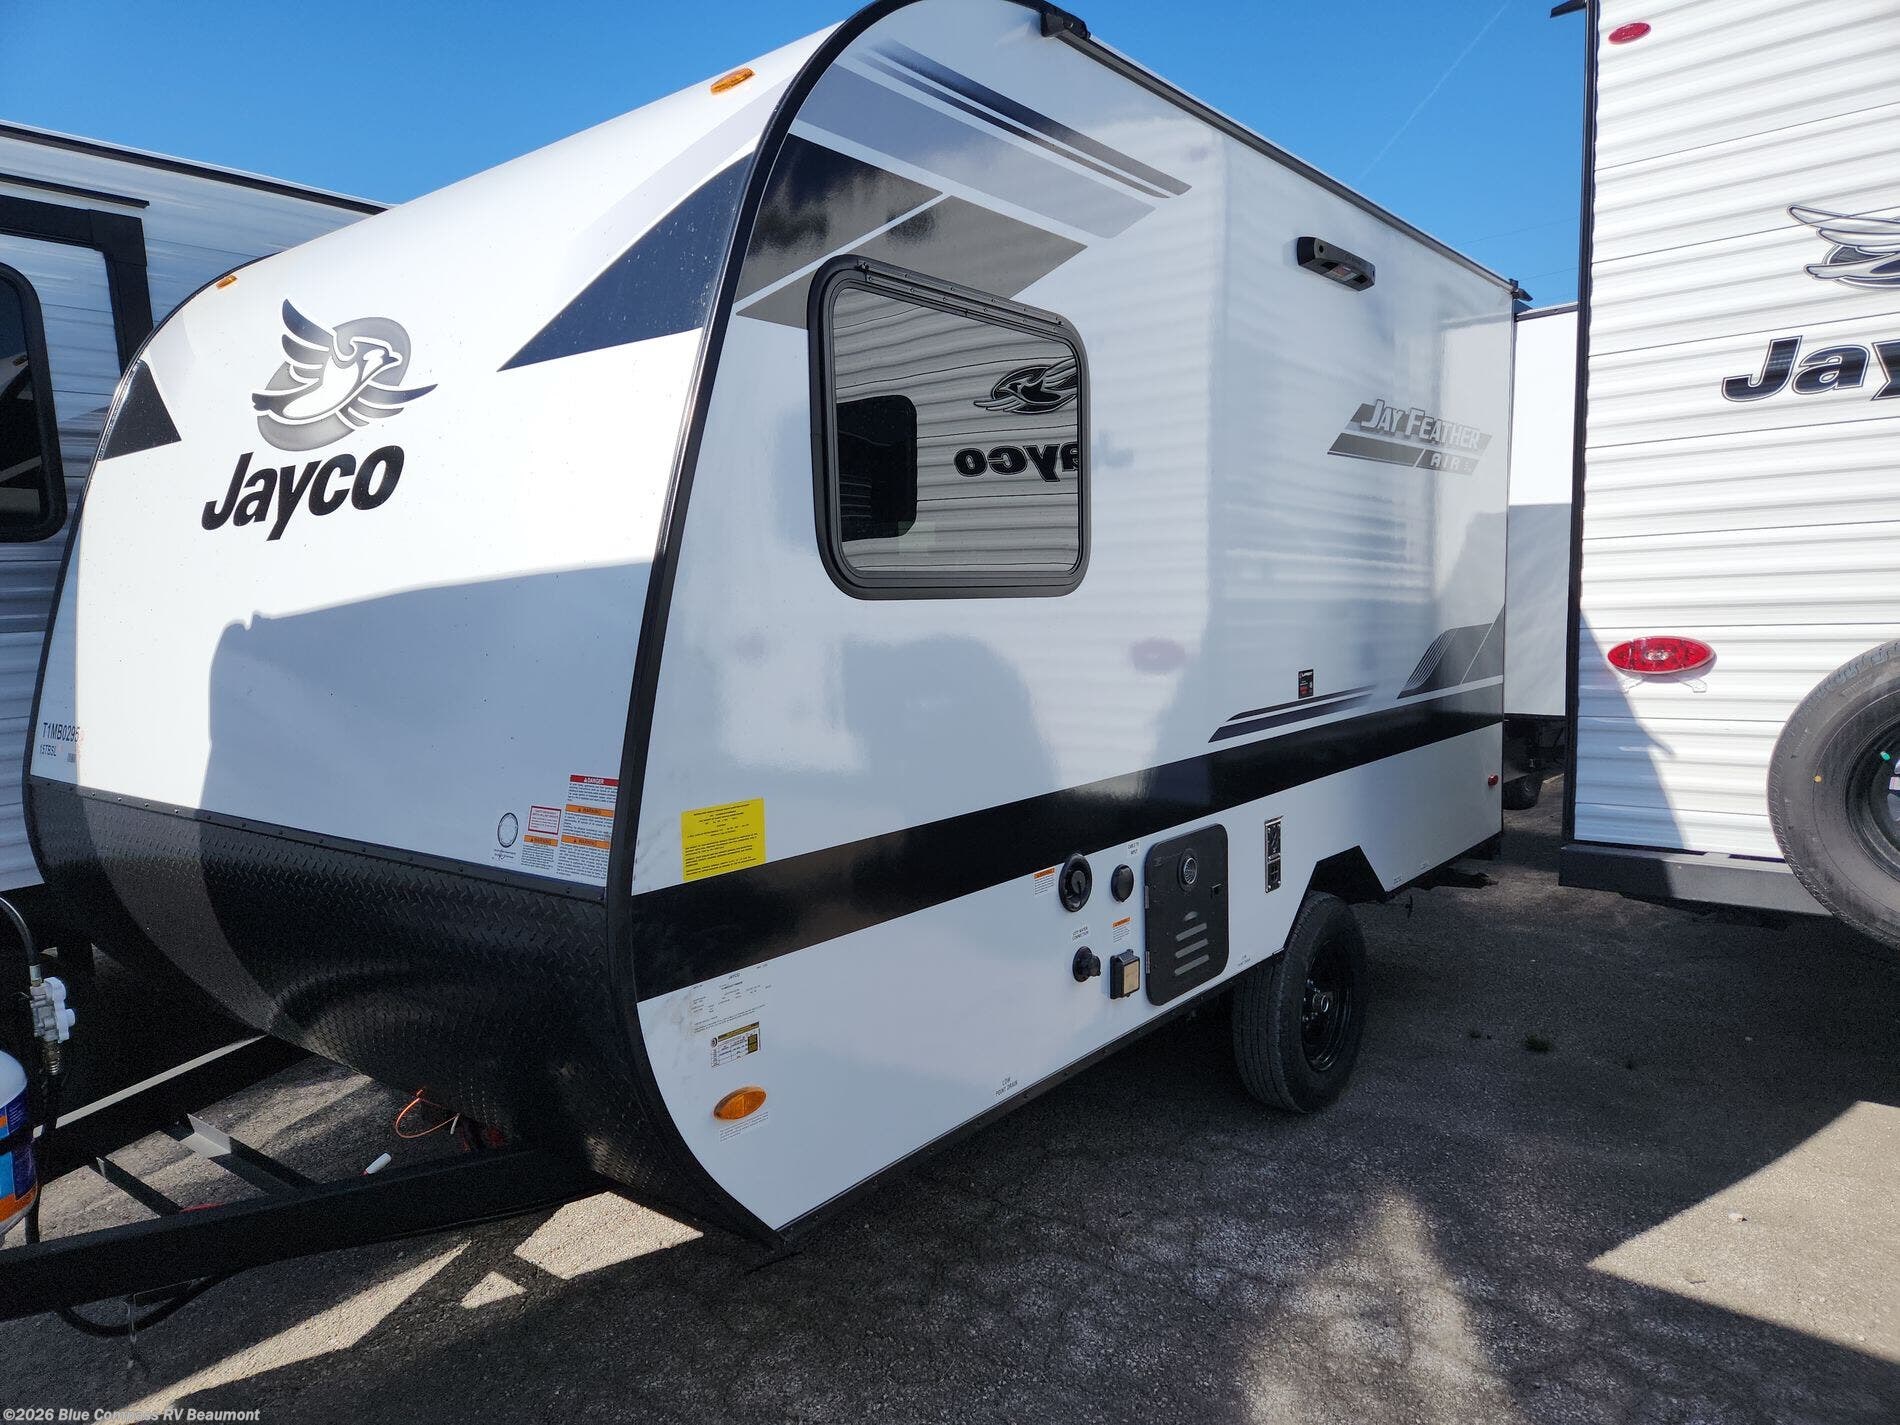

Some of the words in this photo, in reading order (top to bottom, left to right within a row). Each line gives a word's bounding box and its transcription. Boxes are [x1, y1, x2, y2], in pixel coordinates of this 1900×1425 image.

[1360, 398, 1406, 433] JAY
[1405, 407, 1481, 450] FEATHER
[201, 445, 405, 541] Jayco
